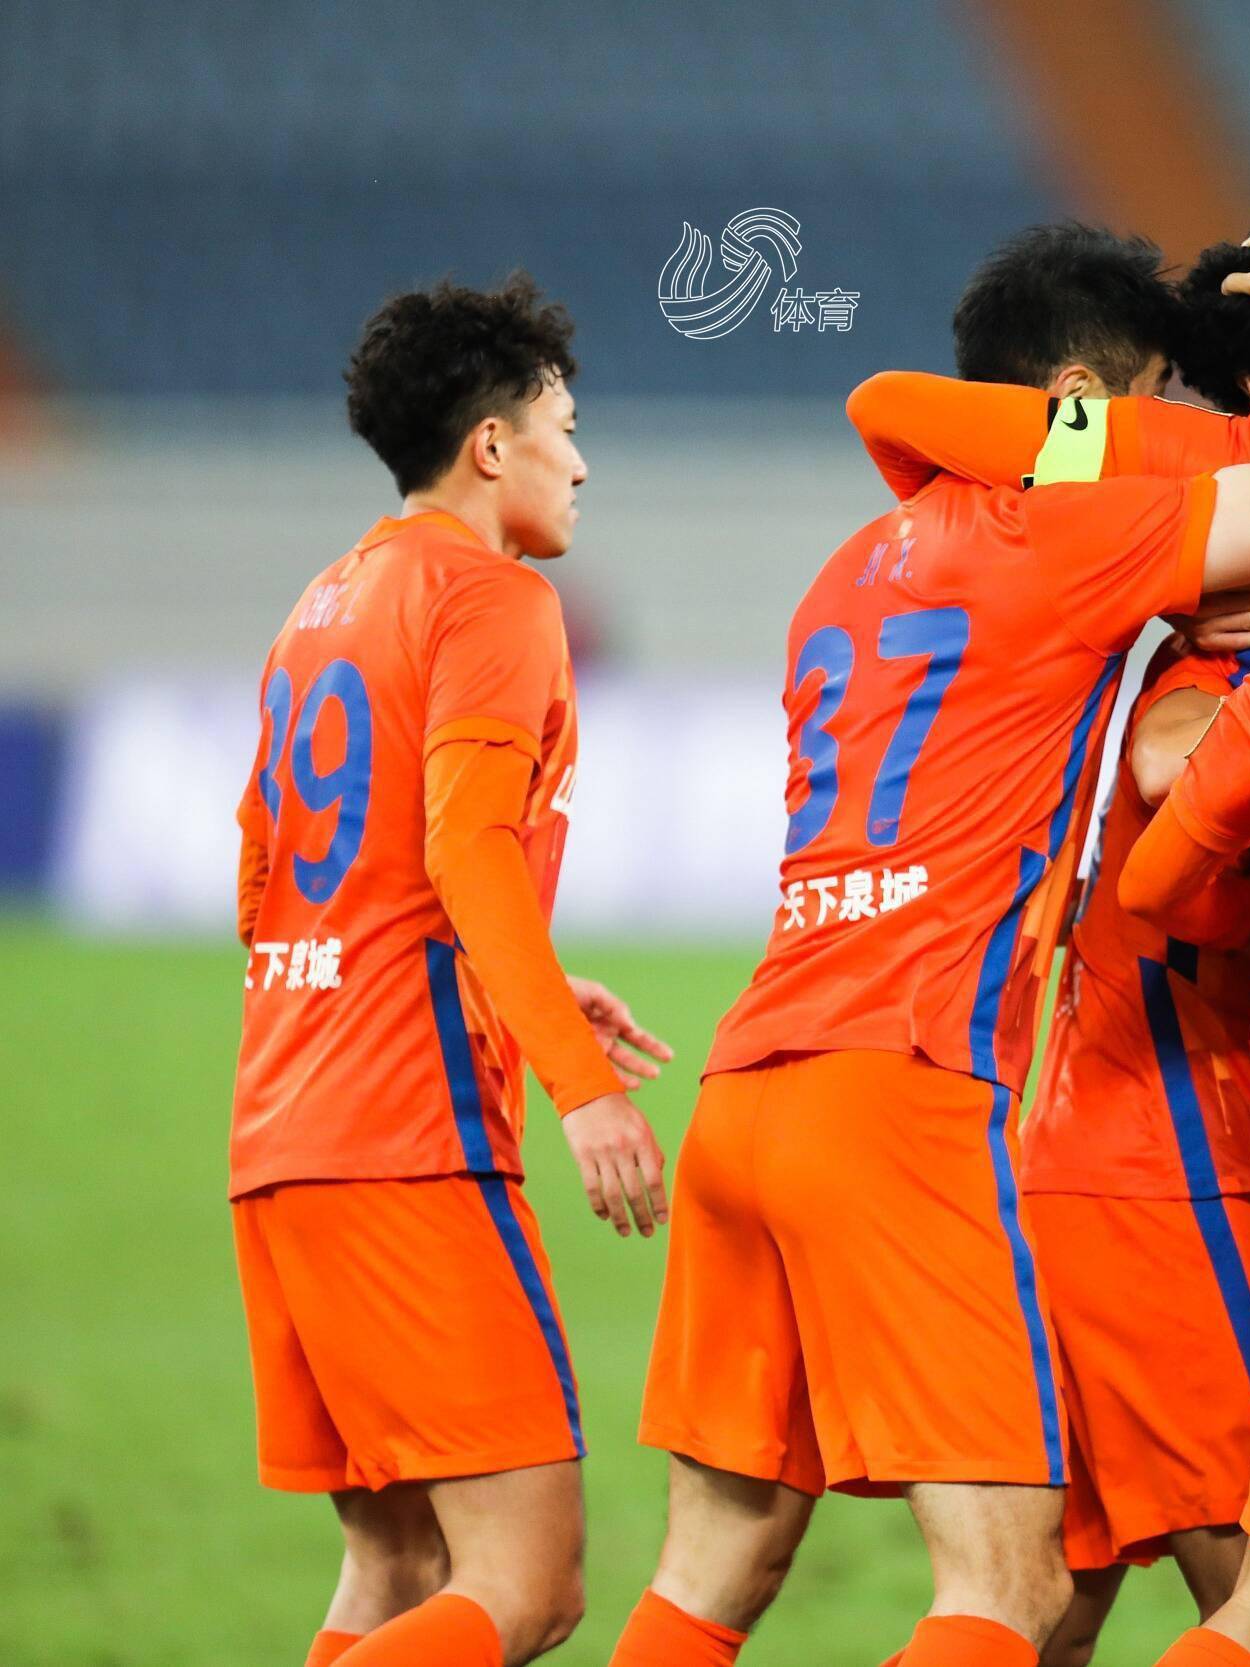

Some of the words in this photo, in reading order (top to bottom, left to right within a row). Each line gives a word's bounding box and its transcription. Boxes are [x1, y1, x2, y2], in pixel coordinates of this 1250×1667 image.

[785, 606, 970, 855] 37
[783, 865, 929, 931] 天下泉城
